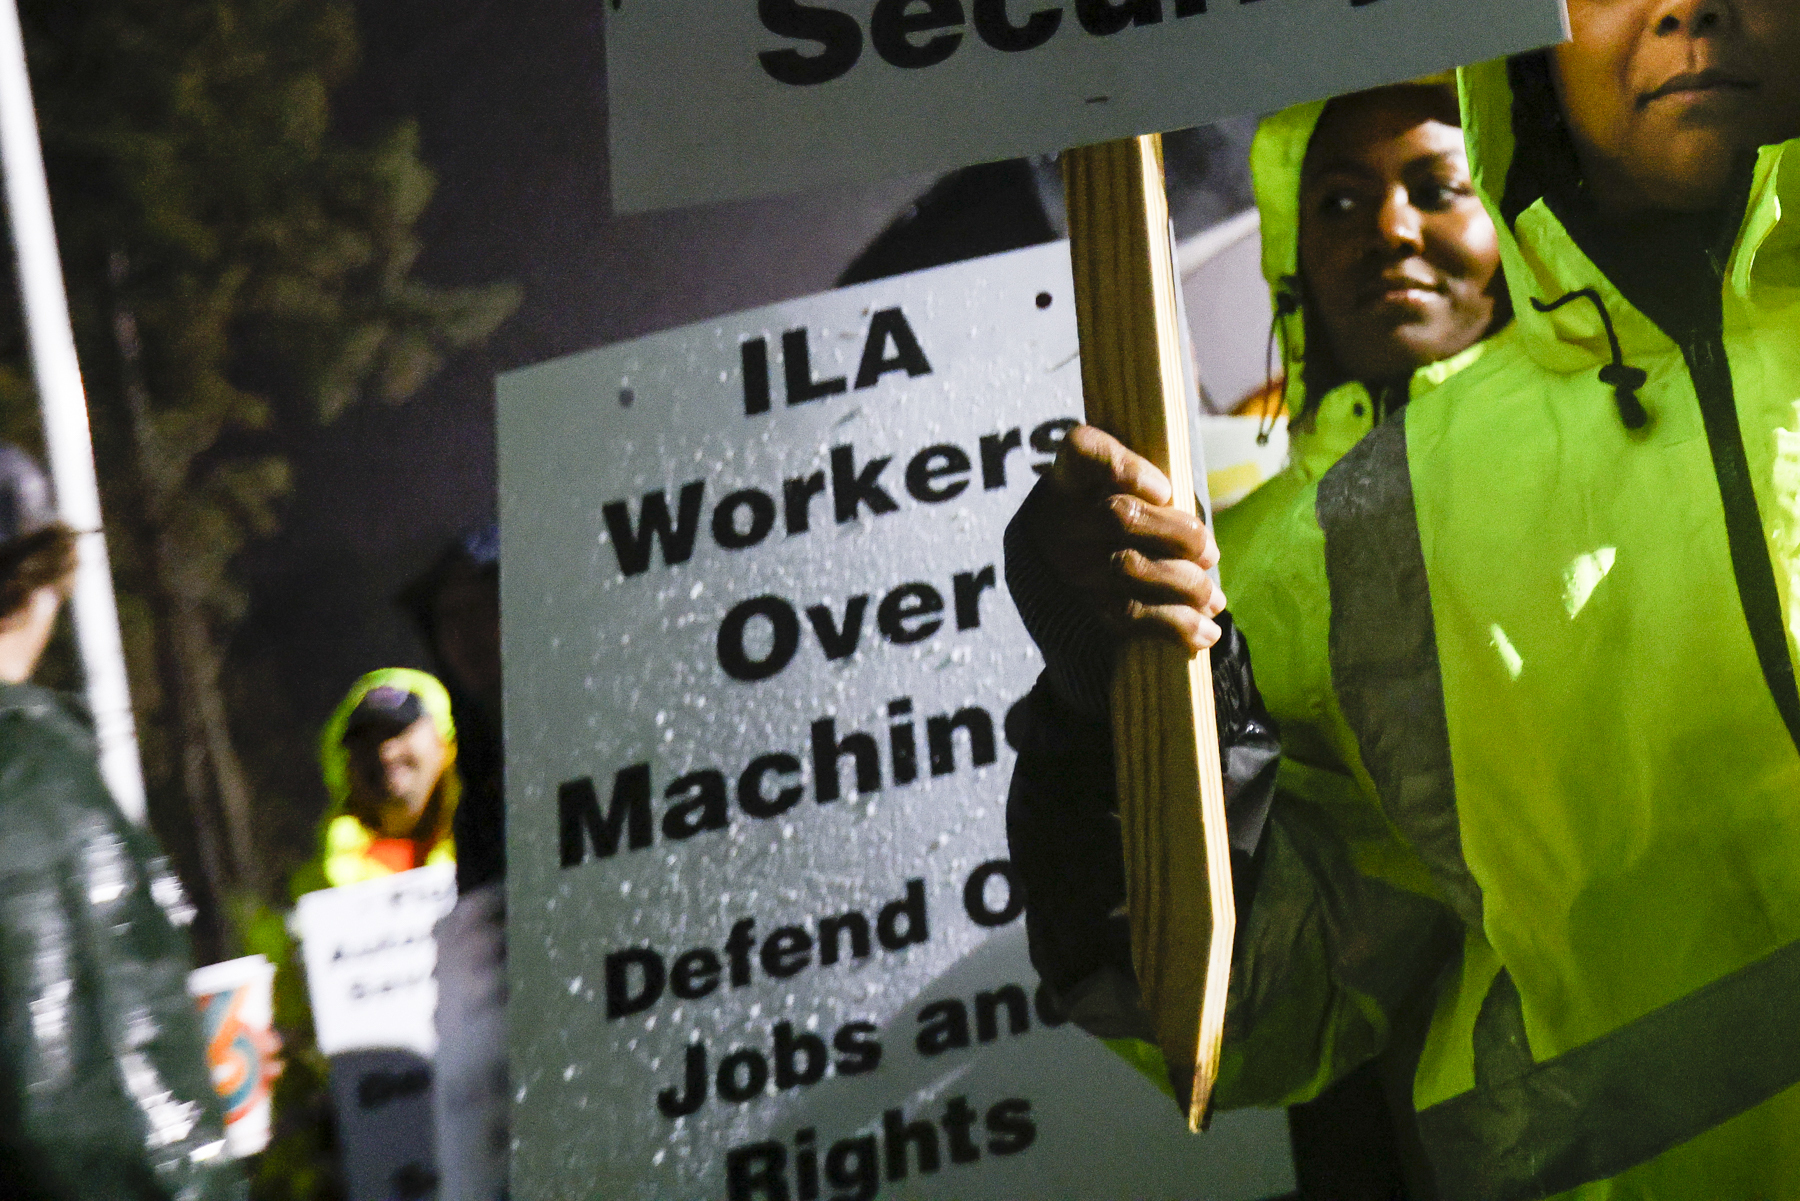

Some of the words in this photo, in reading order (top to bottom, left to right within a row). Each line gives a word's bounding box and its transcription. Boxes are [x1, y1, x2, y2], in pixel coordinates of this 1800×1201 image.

[740, 307, 932, 417] ILA
[716, 564, 996, 682] Over
[605, 879, 926, 1020] Defend
[657, 1021, 883, 1119] Jobs
[726, 1096, 1037, 1201] Rights
